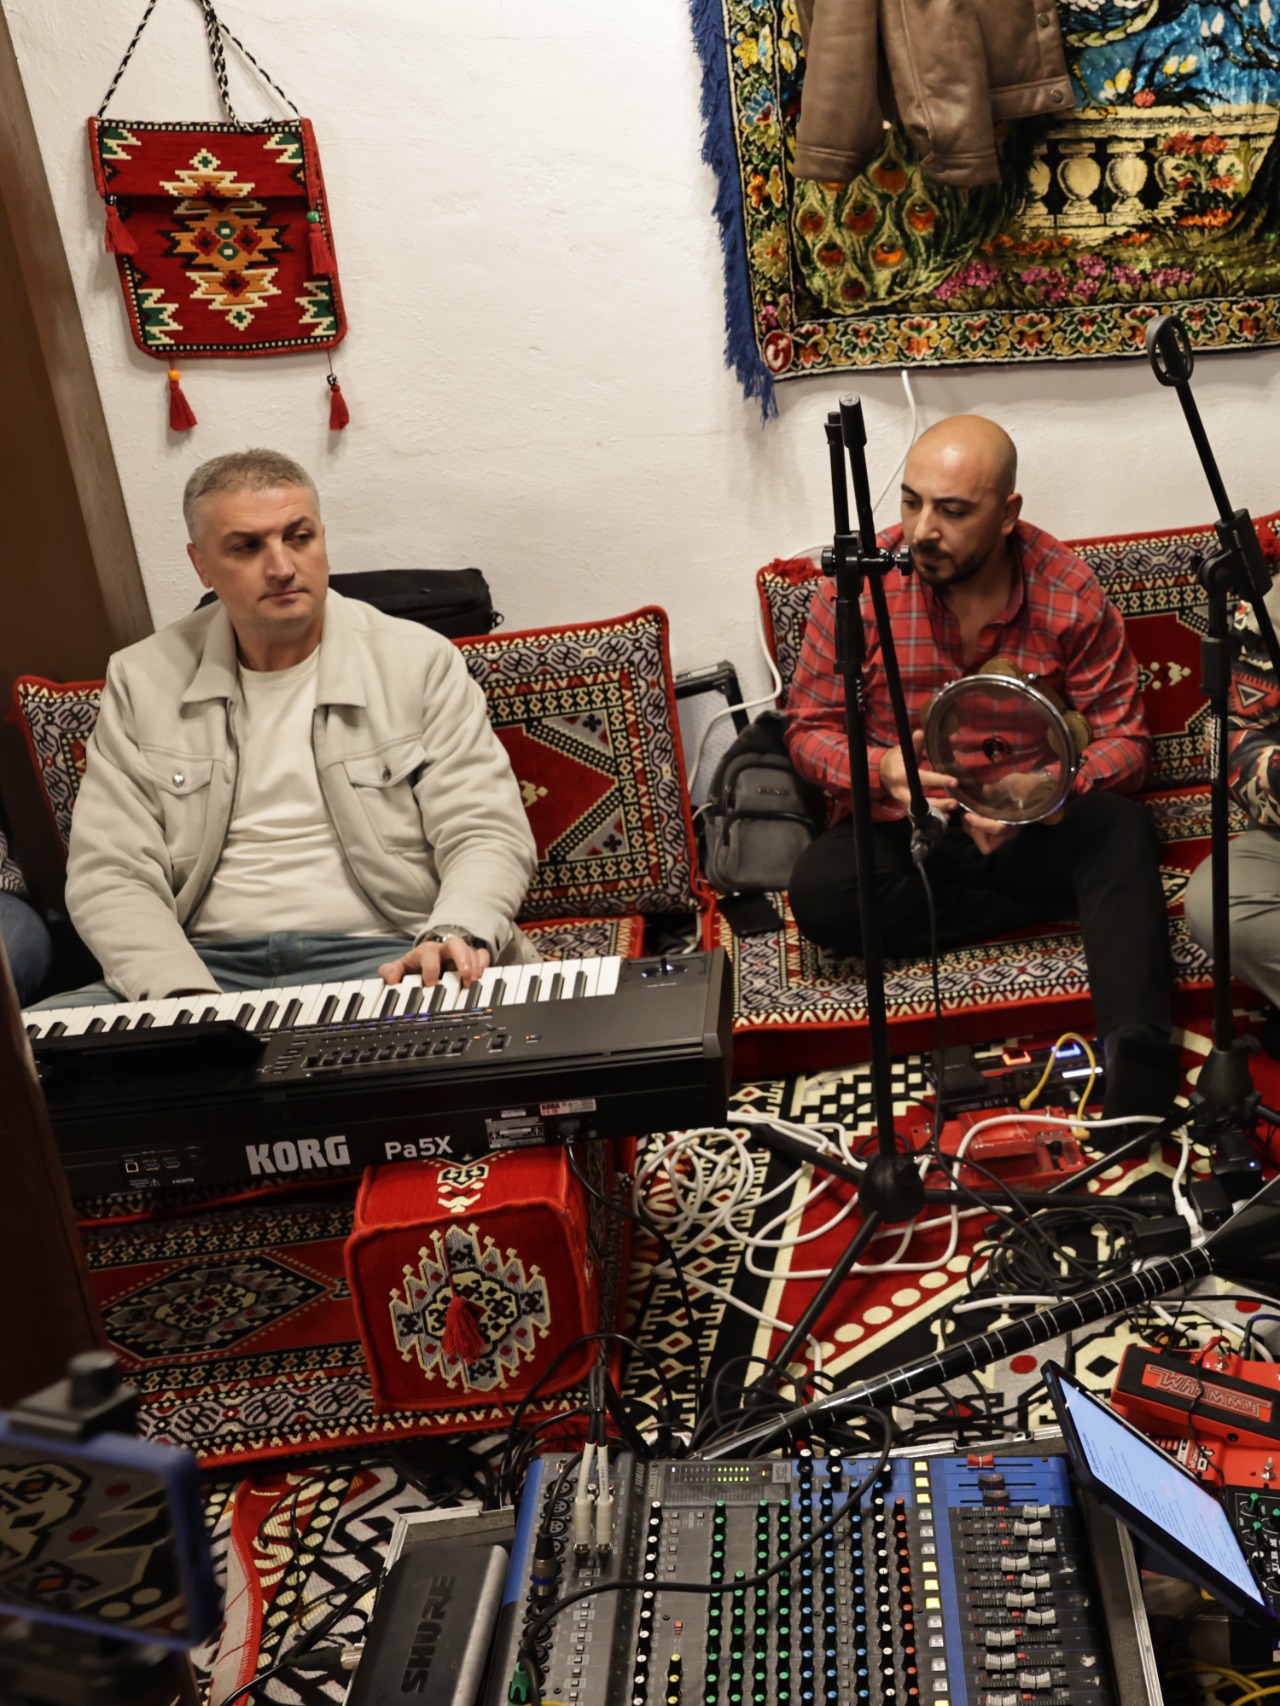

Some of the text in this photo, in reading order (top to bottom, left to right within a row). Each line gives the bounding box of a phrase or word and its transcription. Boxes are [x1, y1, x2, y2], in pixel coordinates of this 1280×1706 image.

[245, 1135, 453, 1175] KORG Pa5X
[400, 1575, 456, 1694] SHURE
